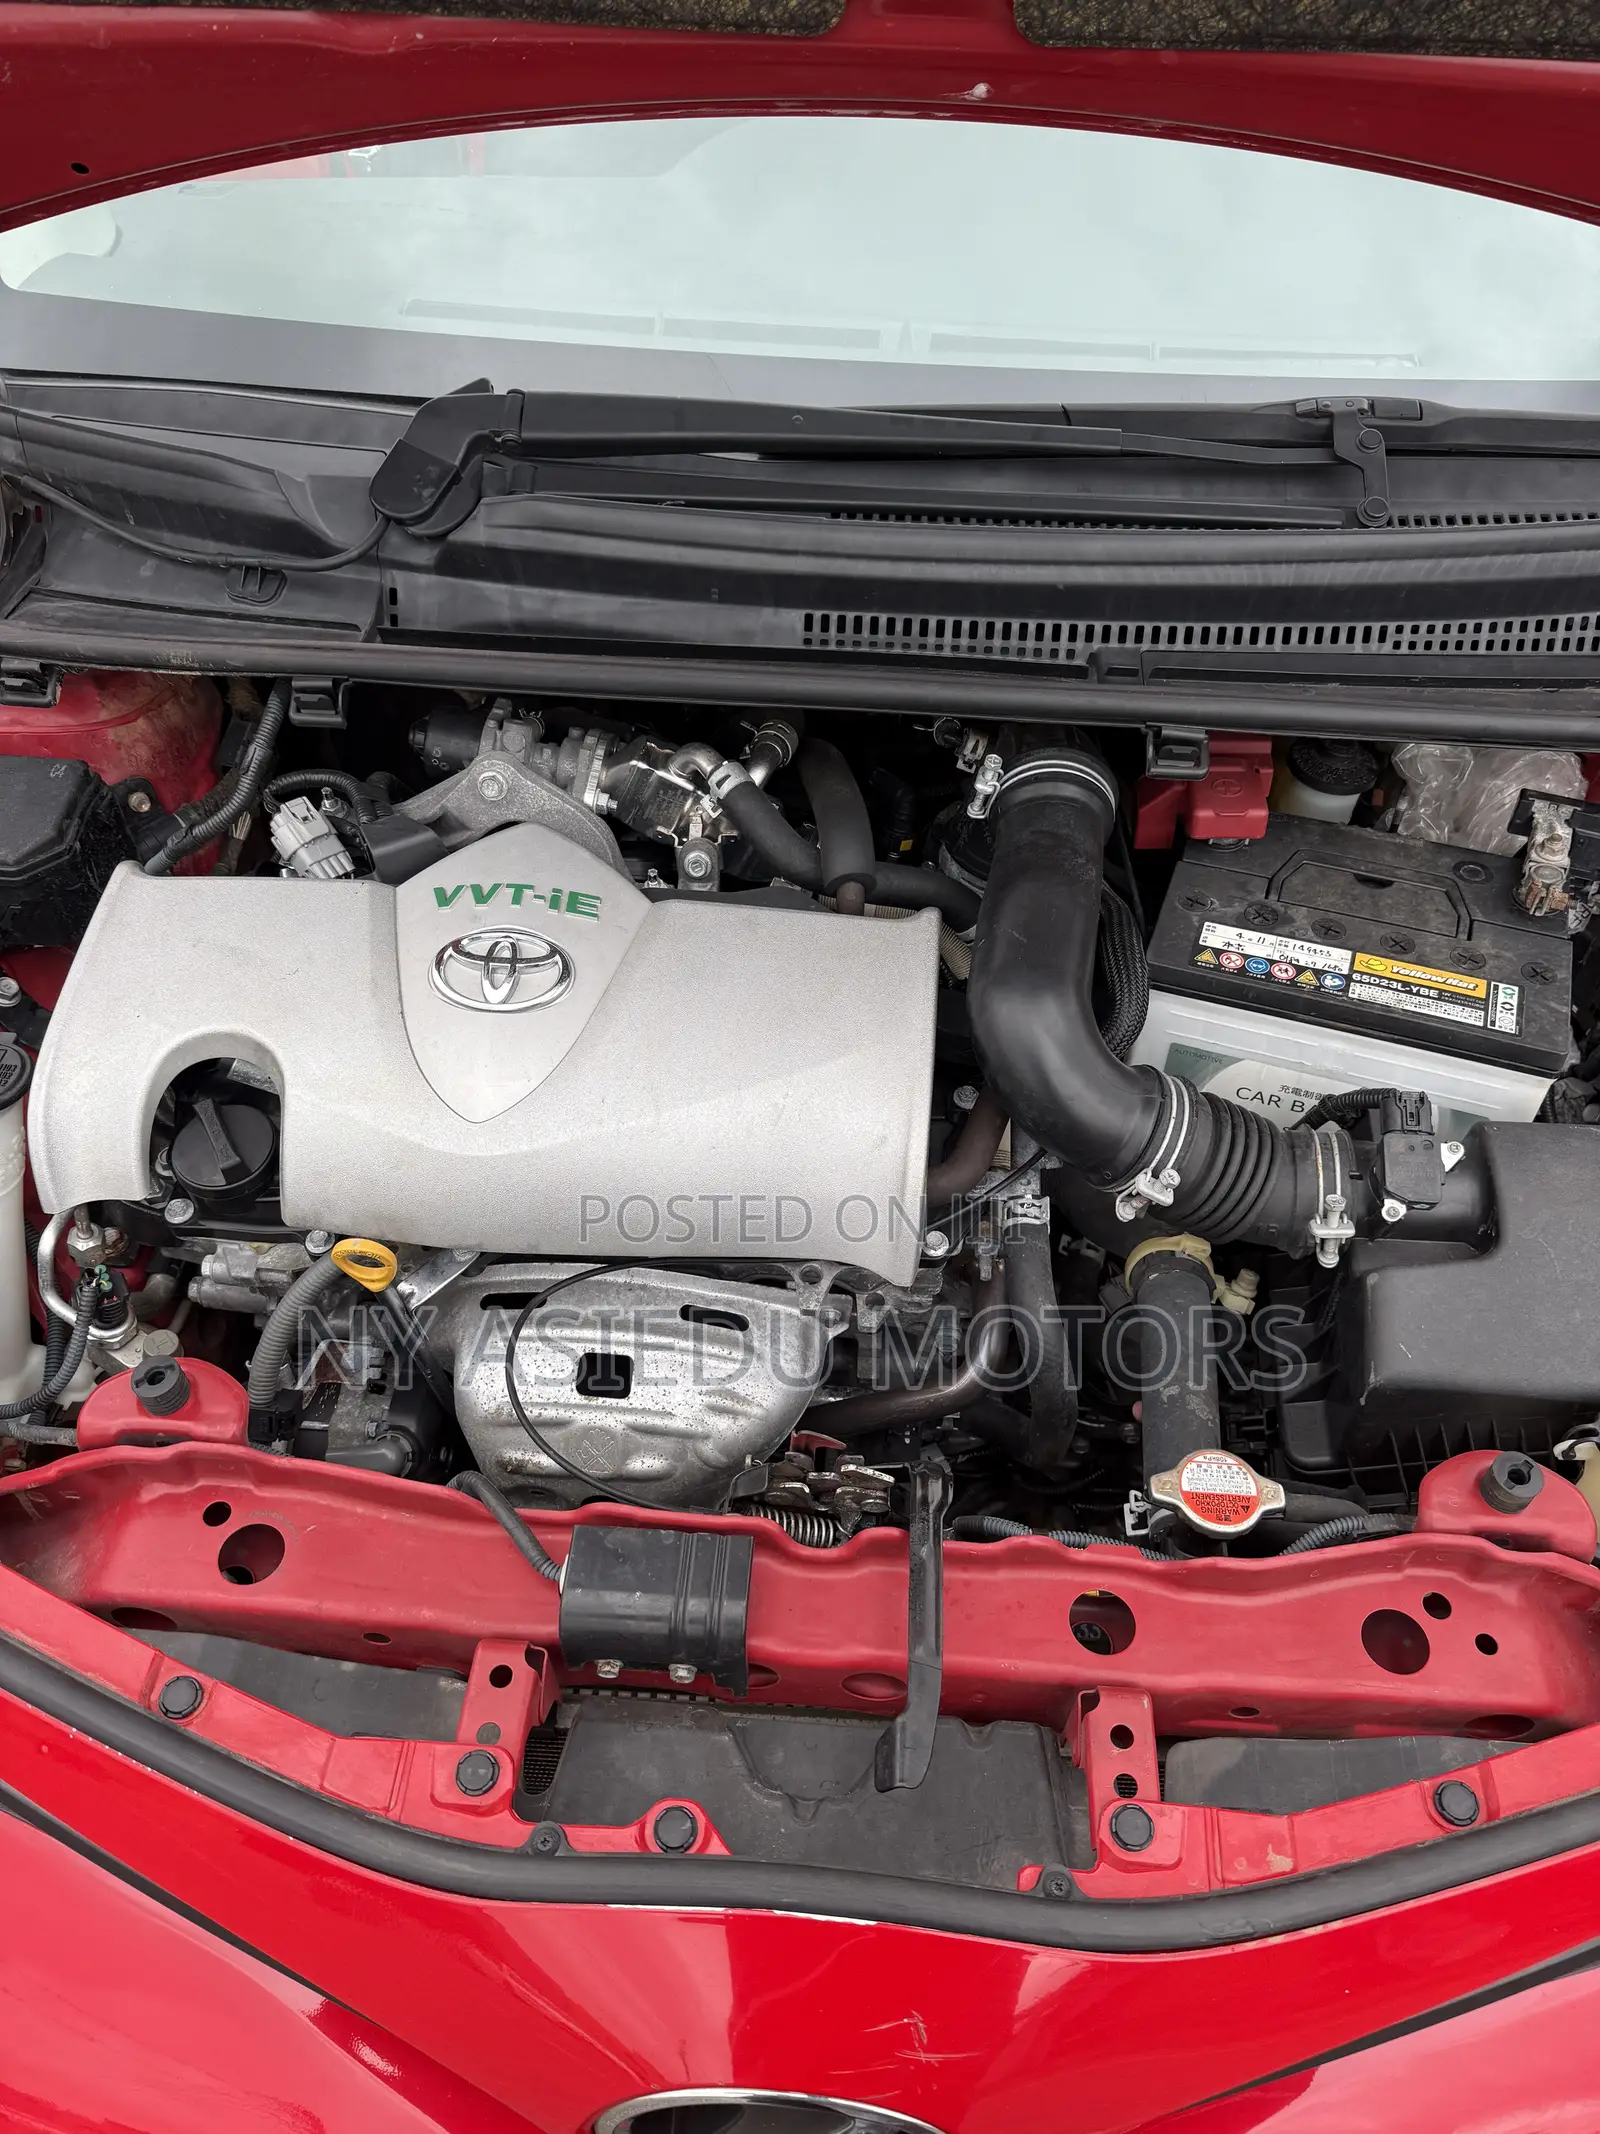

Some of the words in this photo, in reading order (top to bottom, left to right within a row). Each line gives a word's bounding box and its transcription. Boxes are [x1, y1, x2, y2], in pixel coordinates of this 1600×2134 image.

[433, 883, 602, 922] VVT-iE
[1352, 973, 1439, 998] 65D23L-YBE
[1174, 1048, 1225, 1065] AUTOMOTIVE
[1236, 1087, 1282, 1109] CAR
[1190, 1492, 1251, 1503] AVERTISSEMENT
[1200, 1506, 1241, 1516] WARNING
